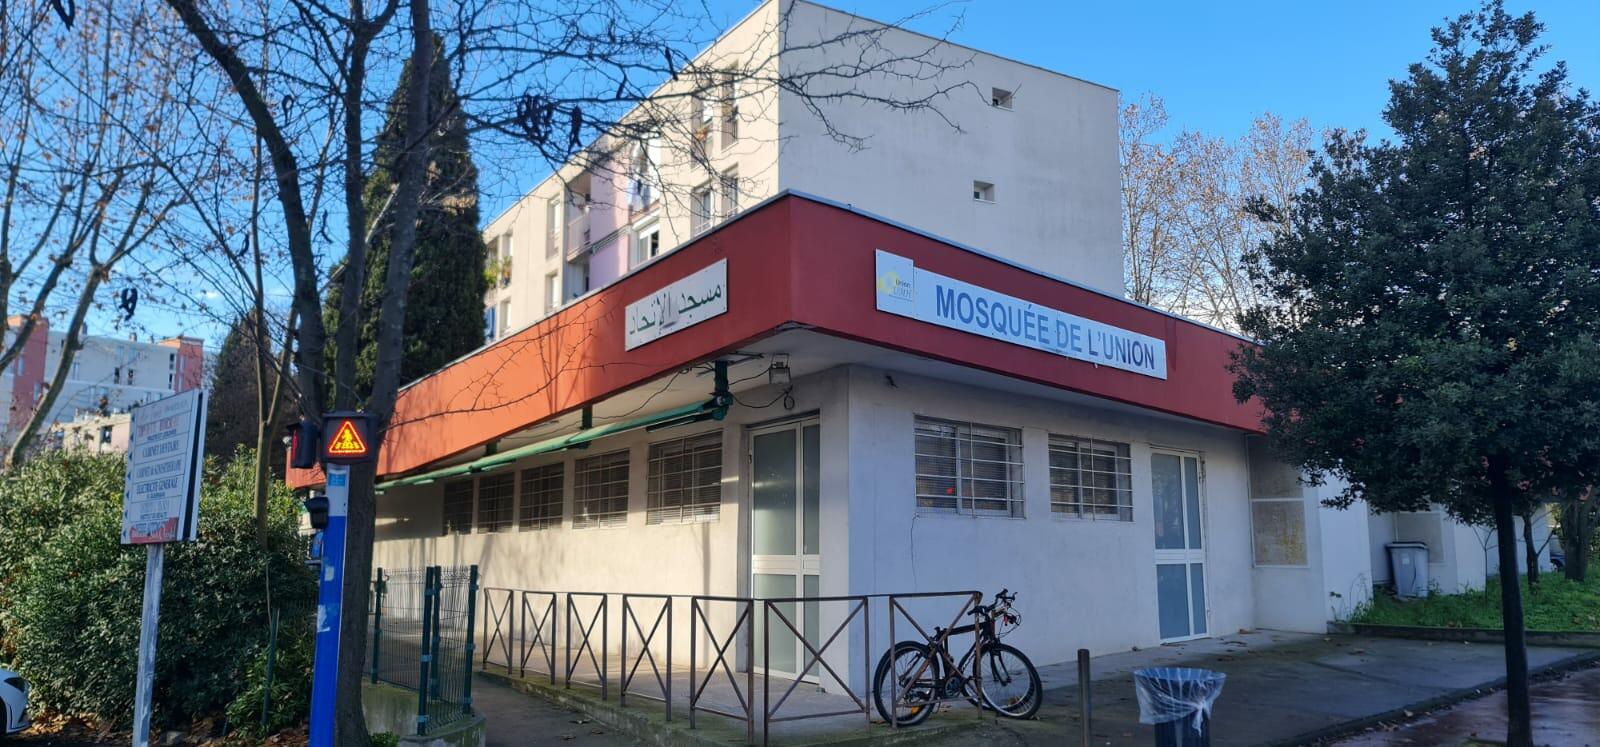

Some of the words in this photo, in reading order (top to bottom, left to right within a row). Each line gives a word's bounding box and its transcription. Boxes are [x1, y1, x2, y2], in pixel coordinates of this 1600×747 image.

[678, 284, 722, 318] مسجد
[935, 284, 1051, 344] MOSQUÉE
[1055, 319, 1083, 353] DE
[1088, 328, 1155, 370] L'UNION
